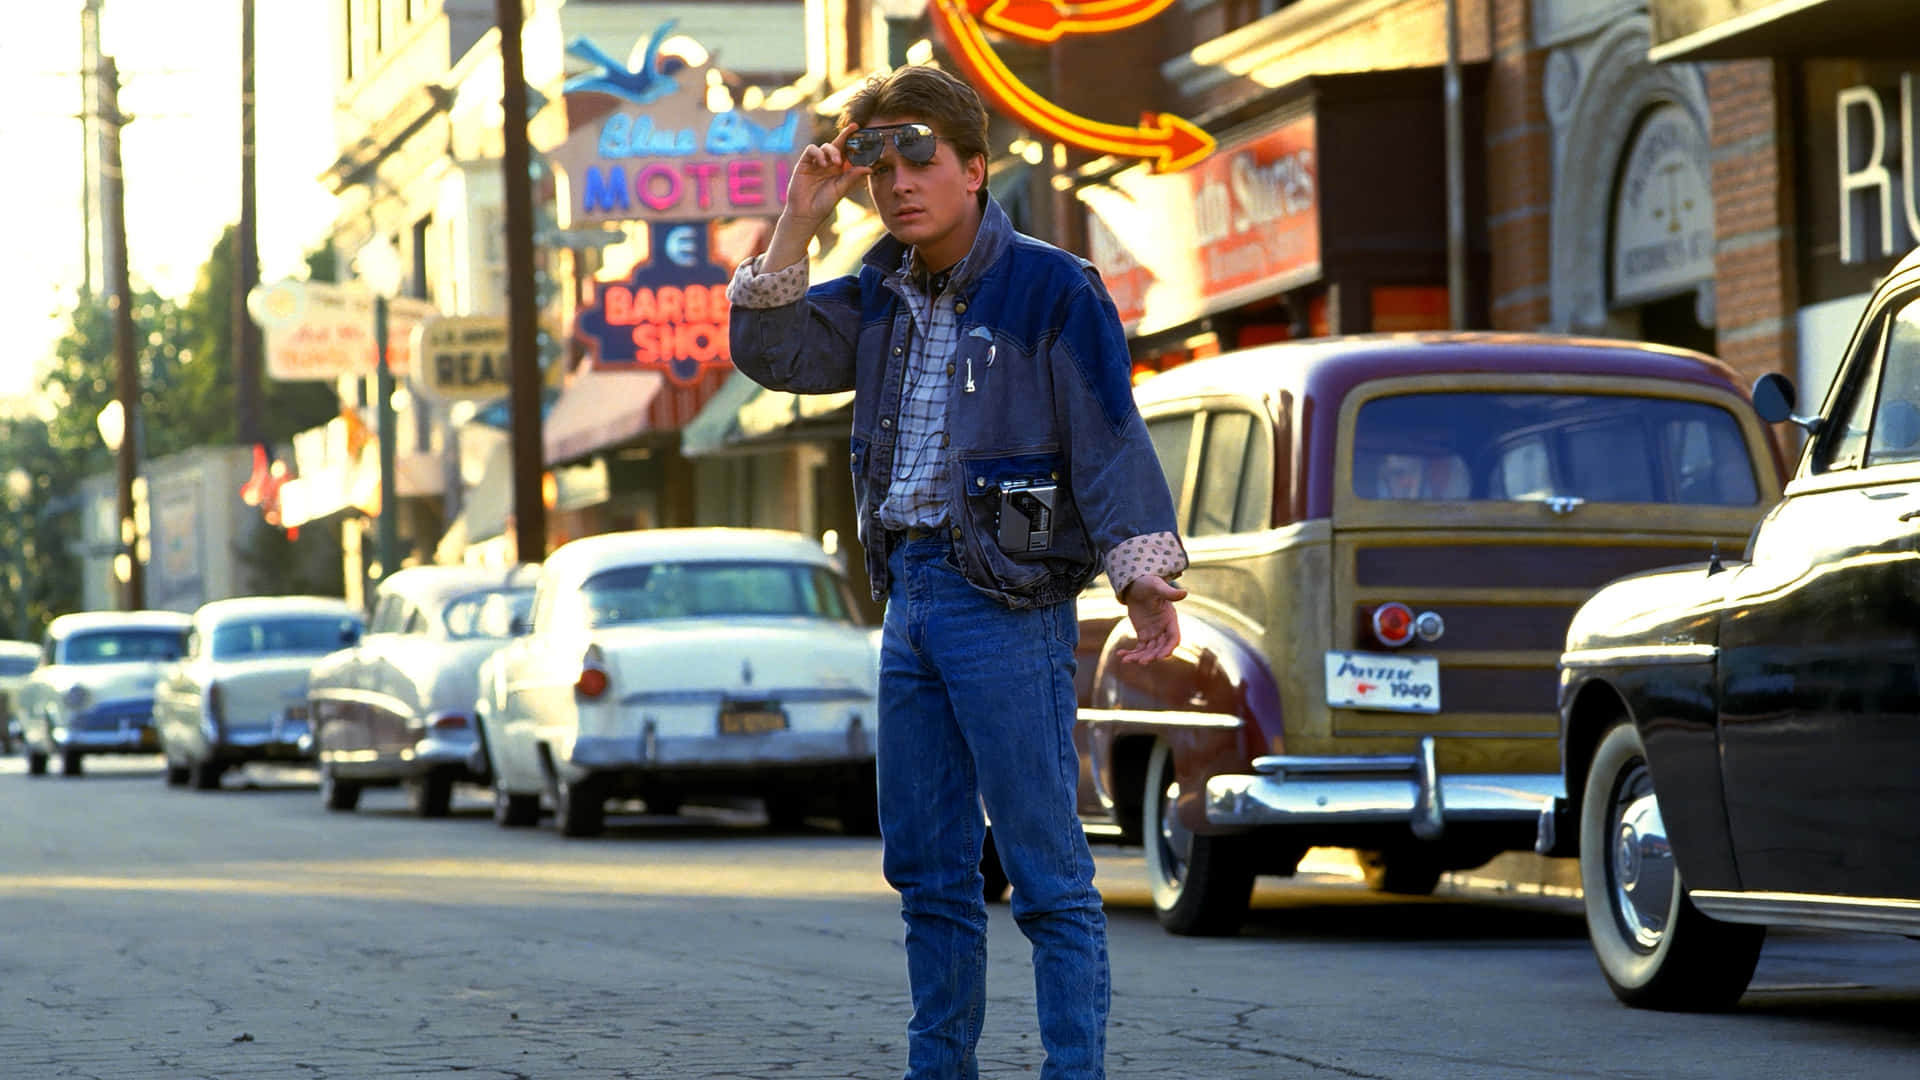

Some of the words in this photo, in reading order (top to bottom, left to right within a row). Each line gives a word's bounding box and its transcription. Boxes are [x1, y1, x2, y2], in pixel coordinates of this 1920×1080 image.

[598, 111, 698, 159] Blue
[704, 109, 800, 156] Bird
[1390, 681, 1433, 700] 1949
